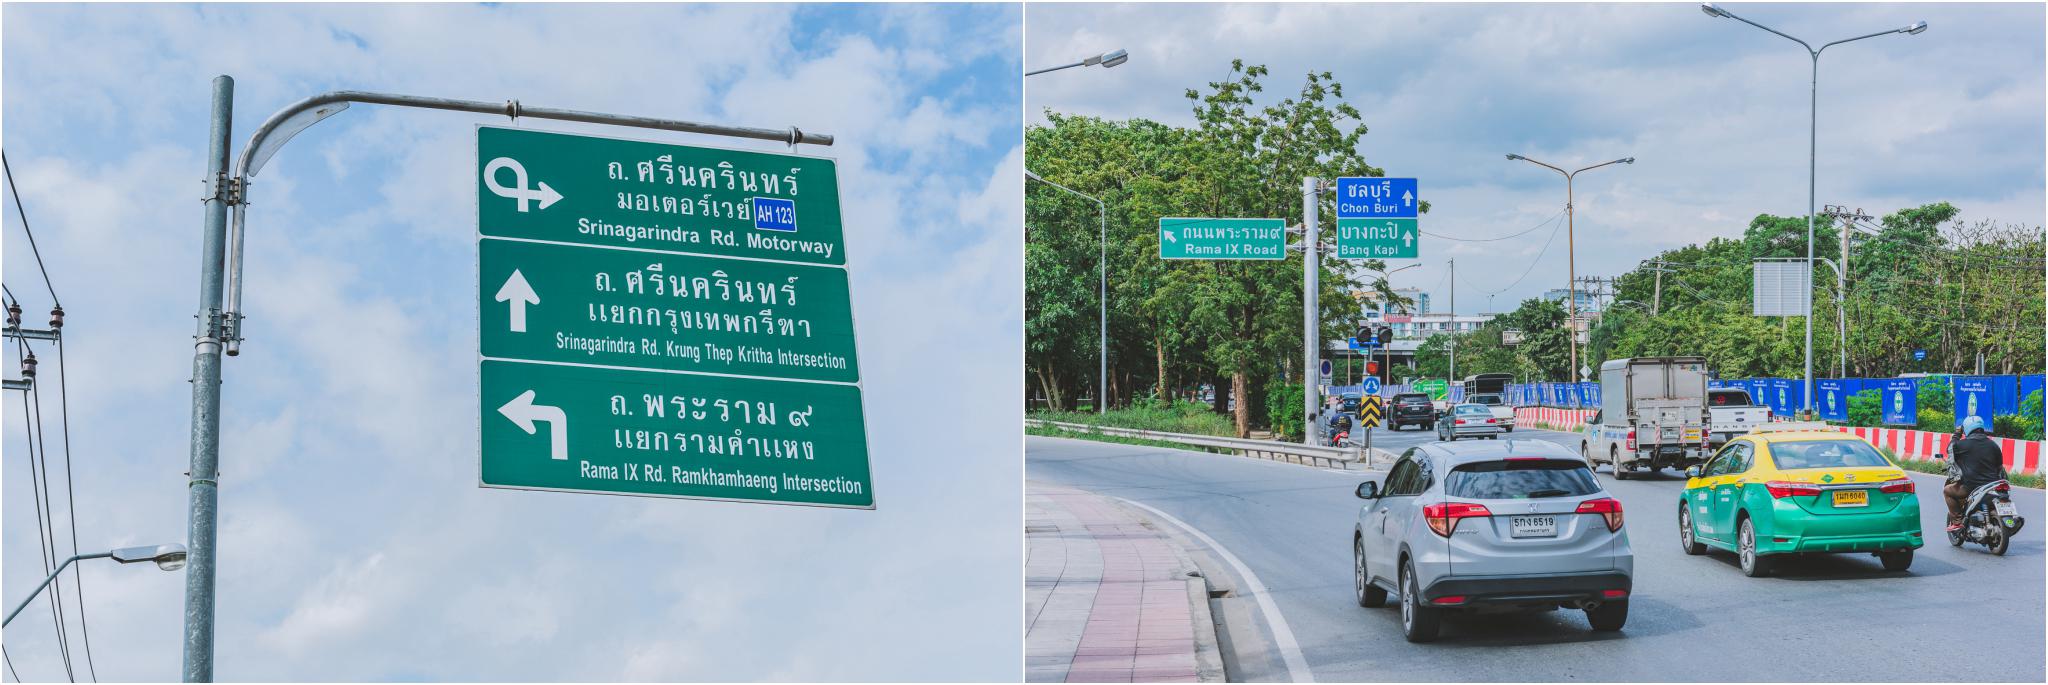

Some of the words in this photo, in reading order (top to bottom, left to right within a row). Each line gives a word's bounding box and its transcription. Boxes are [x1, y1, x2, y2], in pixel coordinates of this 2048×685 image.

[609, 162, 628, 180] ถ.
[637, 155, 800, 195] ศรีนครินทร์
[1348, 181, 1390, 202] ชลบุรี
[618, 192, 751, 220] มอเตอร์เวย์
[758, 205, 772, 222] AH
[776, 207, 793, 224] 123
[1342, 203, 1368, 212] Chon
[1375, 204, 1397, 212] Buri
[578, 218, 699, 243] Srinagarindra
[711, 230, 739, 246] Rd.
[747, 233, 833, 258] Motorway
[1183, 226, 1281, 240] ถนนพระราม๙
[1342, 222, 1397, 239] บางกะปิ
[1186, 244, 1221, 254] Rama
[1226, 244, 1238, 254] IX
[1244, 244, 1277, 254] Road
[1342, 245, 1369, 256] Bang
[1375, 246, 1398, 255] Kapi
[596, 273, 616, 291] ถ.
[626, 263, 798, 305] ศรีนครินทร์
[589, 304, 810, 337] แยกกรุงเทพกรีฑา
[557, 332, 635, 355] Srinagarindra
[642, 339, 660, 355] Rd.
[667, 341, 700, 363] Krung
[705, 343, 732, 364] Thep
[738, 346, 773, 363] Kritha
[778, 349, 845, 368] Intersection
[611, 395, 632, 415] ถ.
[643, 394, 775, 424] พระราม
[789, 405, 812, 426] ๙
[616, 429, 813, 459] แยกรามคำแหง
[581, 461, 618, 479] Rama
[625, 463, 638, 480] IX
[645, 464, 666, 482] Rd.
[672, 466, 777, 493] Ramkhamhaeng
[783, 473, 861, 494] Intersection
[1533, 517, 1554, 526] 6519
